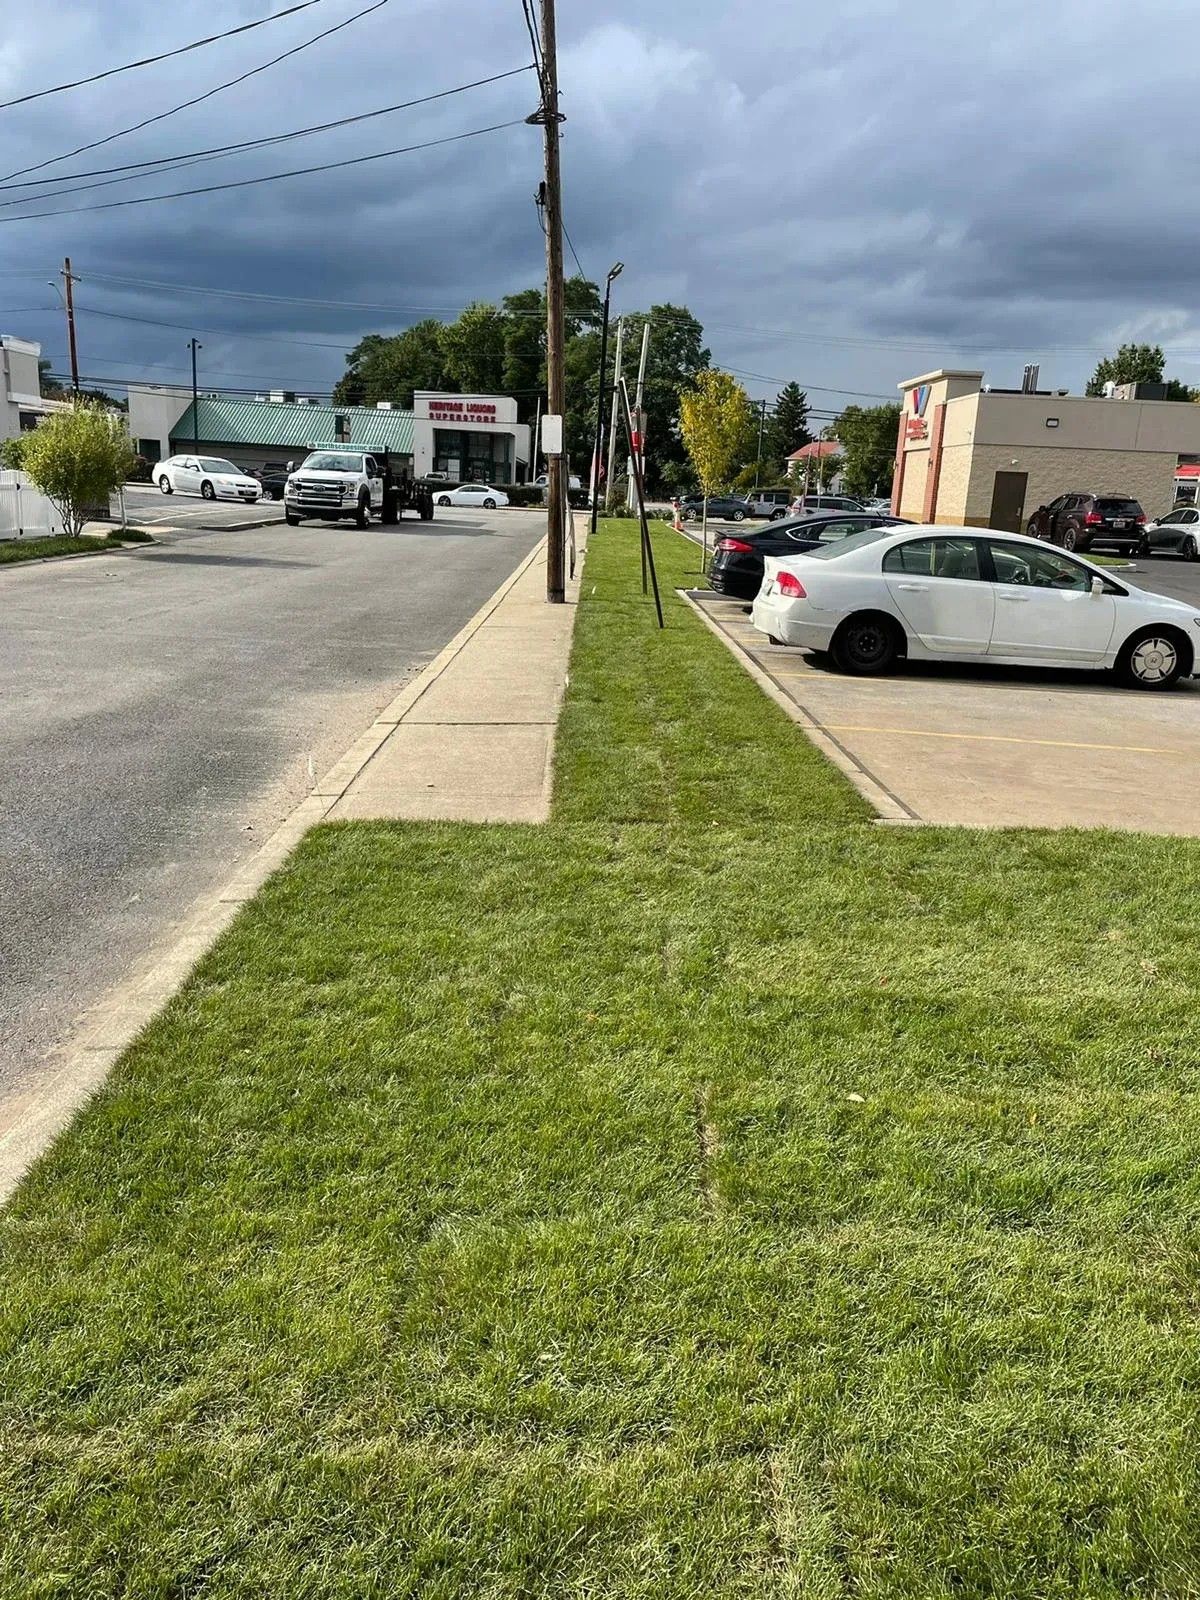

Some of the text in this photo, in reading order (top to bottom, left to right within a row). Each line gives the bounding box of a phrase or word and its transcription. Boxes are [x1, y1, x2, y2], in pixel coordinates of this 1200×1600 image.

[428, 401, 496, 414] HERITAGE LIQUORS
[428, 412, 496, 423] SUPERSTORE
